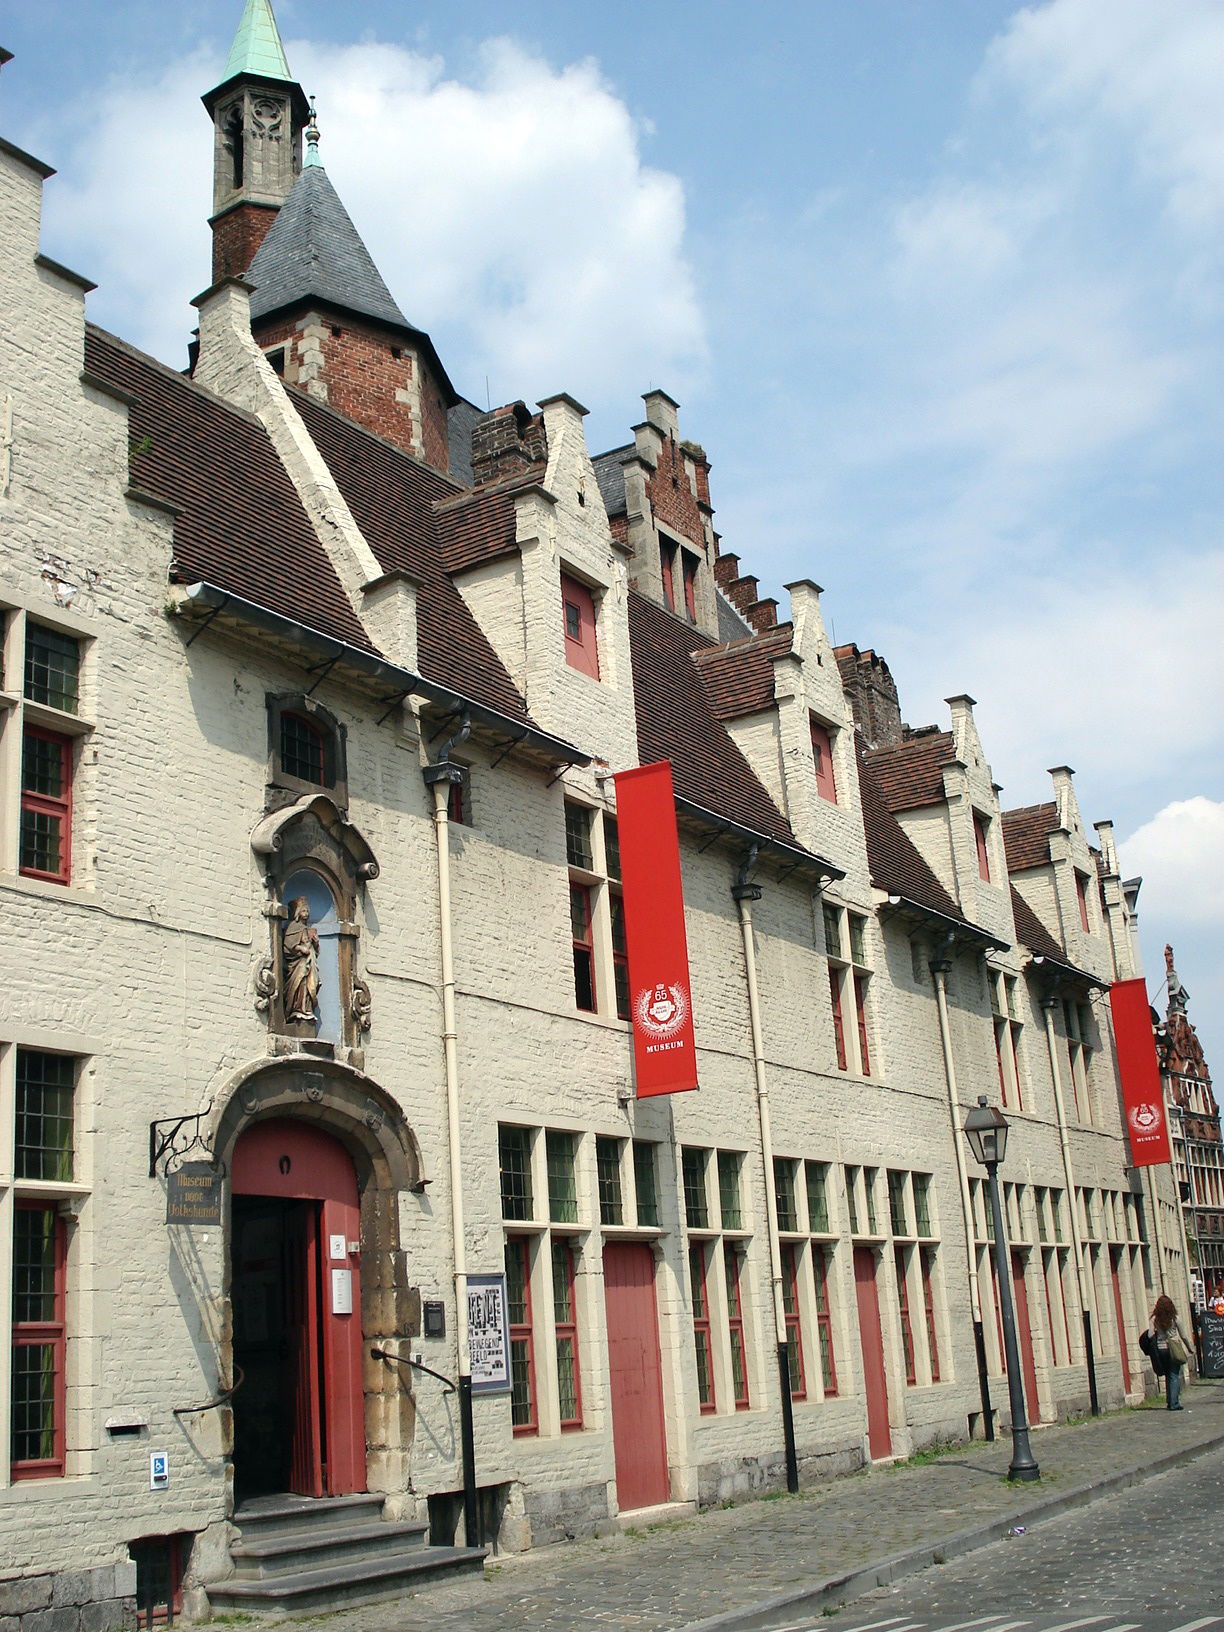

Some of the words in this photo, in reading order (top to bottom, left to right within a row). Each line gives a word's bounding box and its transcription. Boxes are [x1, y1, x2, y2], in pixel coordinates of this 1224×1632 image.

[655, 990, 667, 1000] 65
[646, 1041, 684, 1053] MUSEUM
[177, 1173, 212, 1187] Museum
